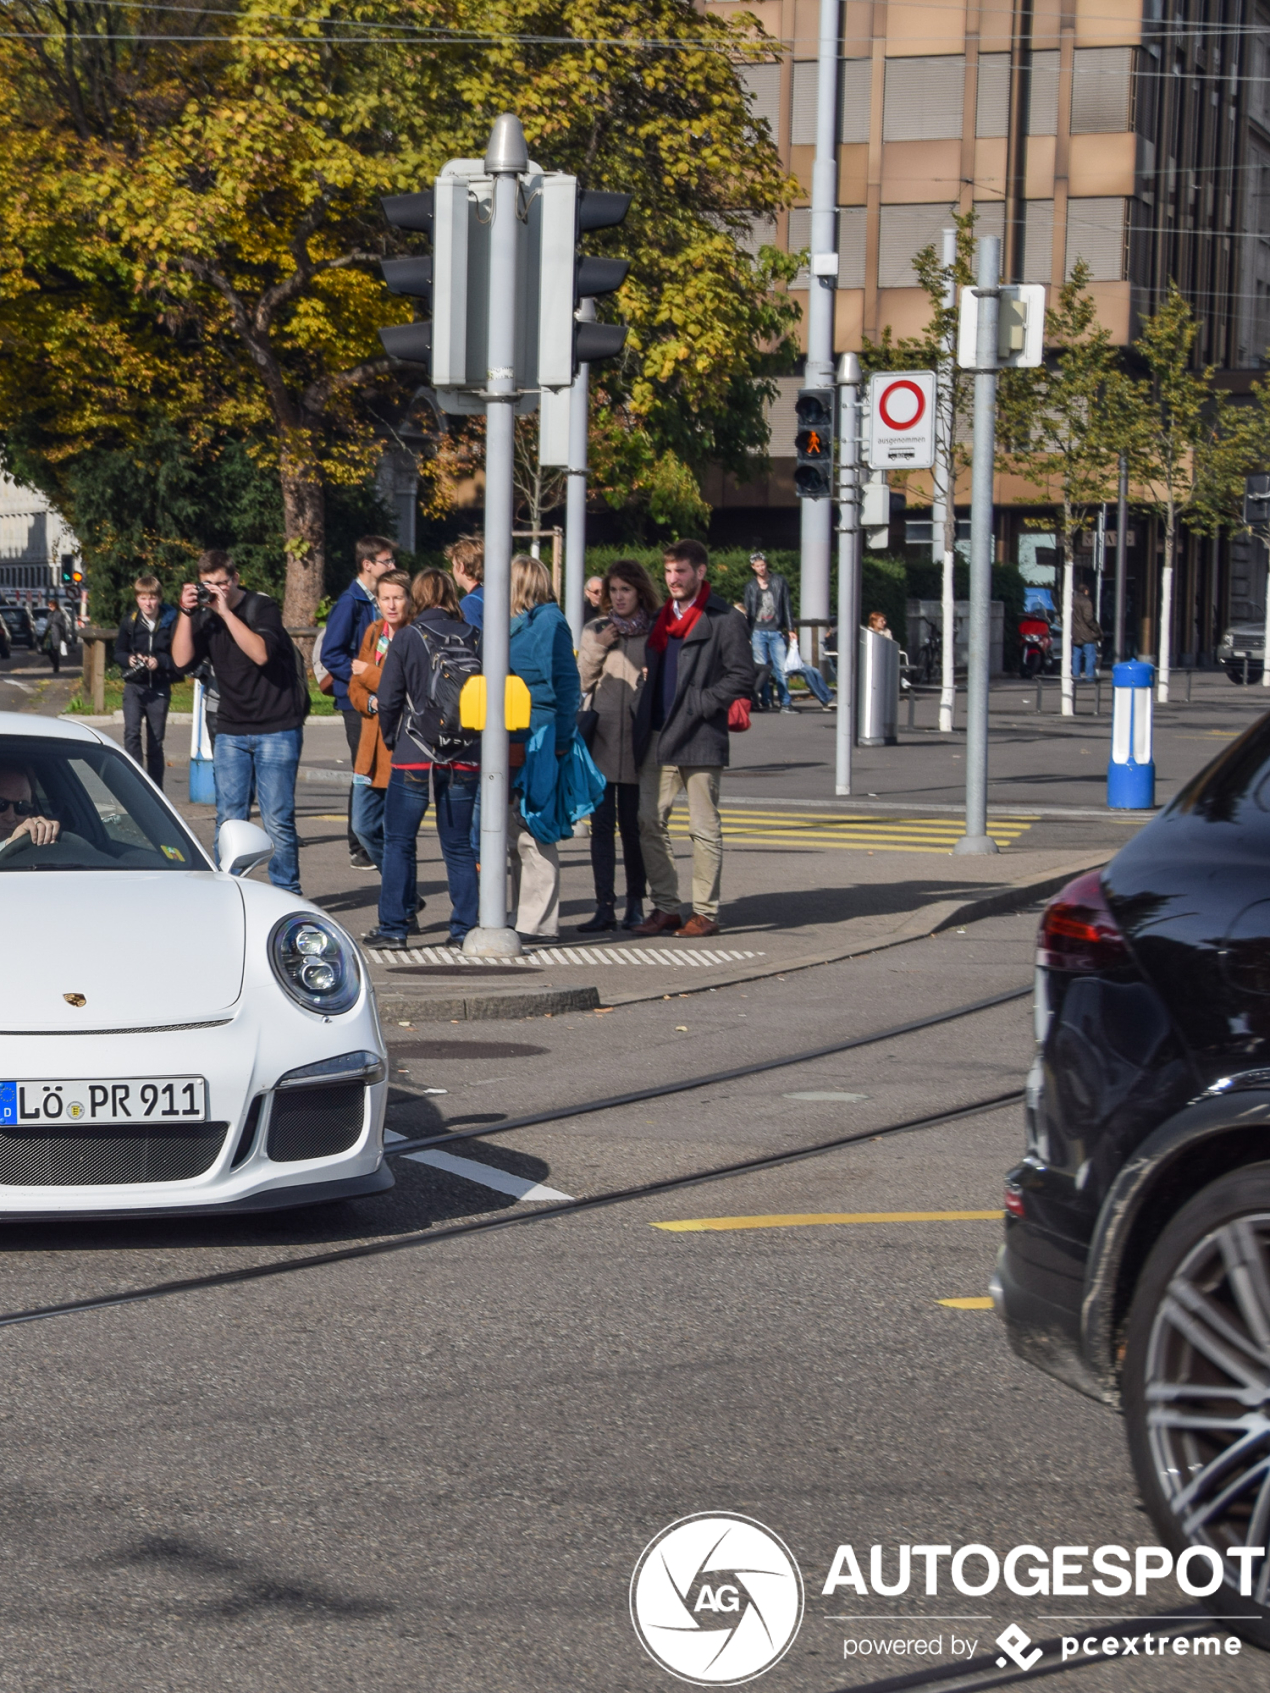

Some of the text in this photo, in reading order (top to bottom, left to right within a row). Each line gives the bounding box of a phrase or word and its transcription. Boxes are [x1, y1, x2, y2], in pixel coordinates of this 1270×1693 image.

[877, 436, 926, 446] ausgenommen
[19, 1083, 200, 1120] LÖ PR 911
[3, 1107, 12, 1118] D
